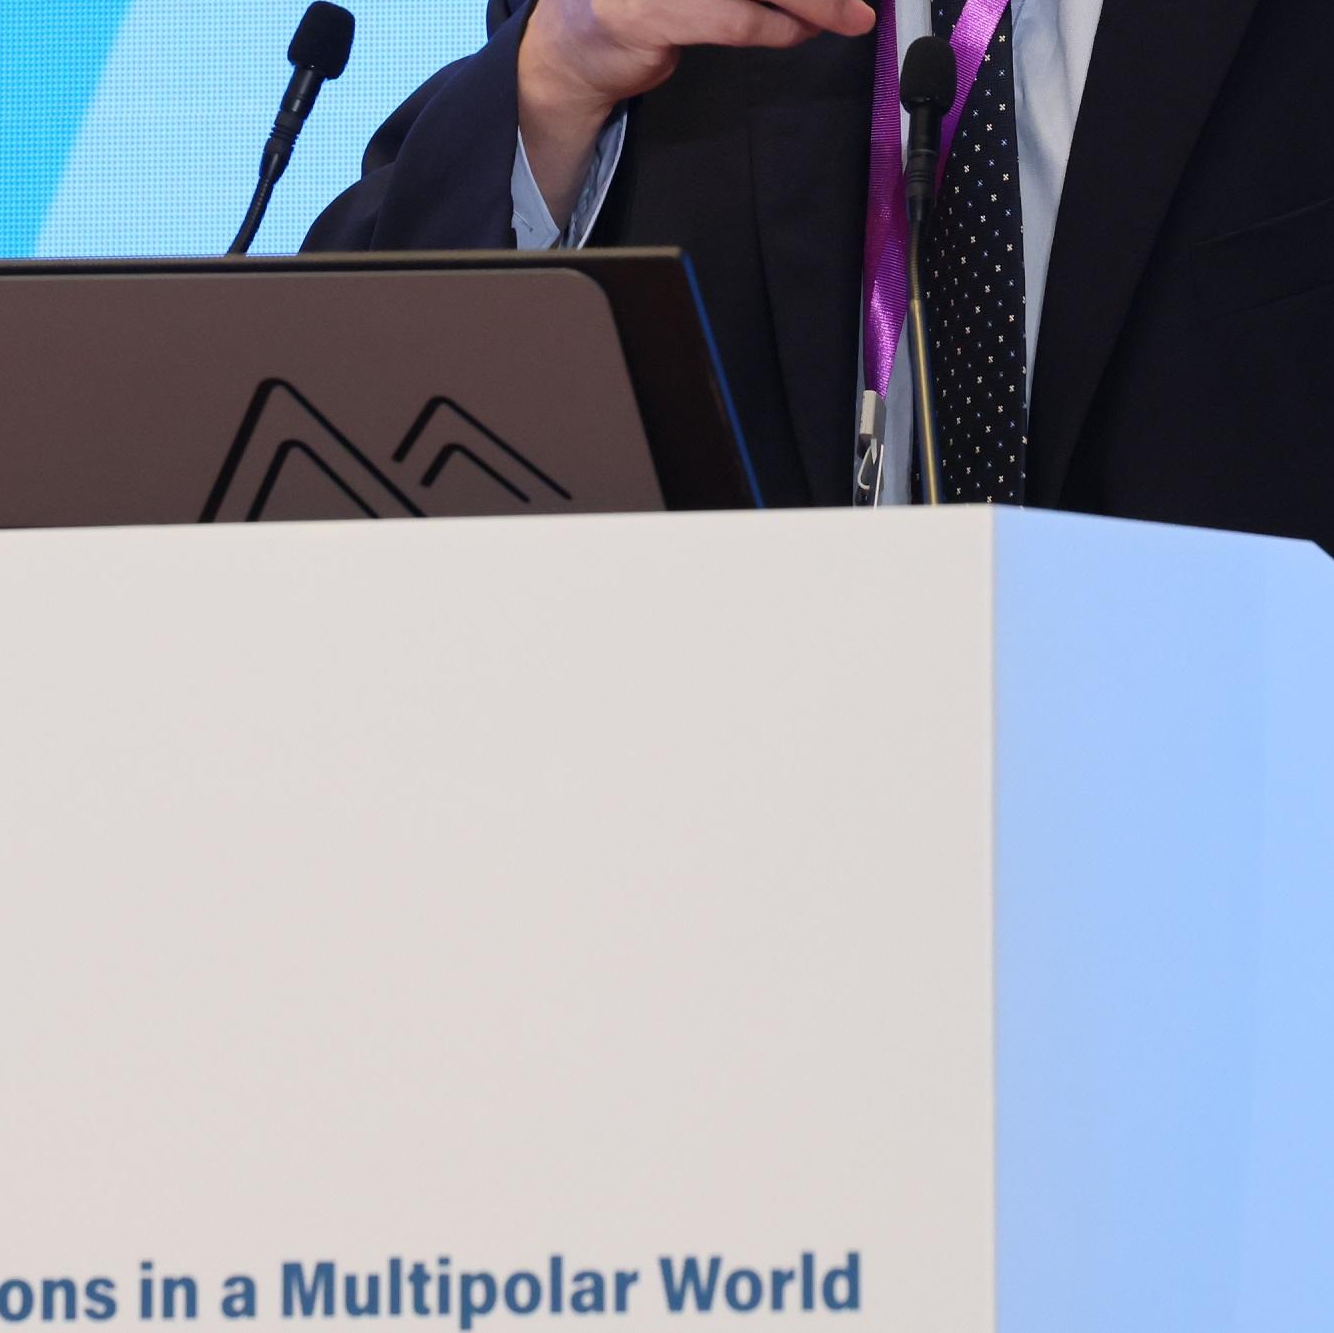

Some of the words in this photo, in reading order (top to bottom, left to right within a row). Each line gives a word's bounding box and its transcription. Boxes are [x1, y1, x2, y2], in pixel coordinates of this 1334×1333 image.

[139, 1261, 198, 1320] in
[220, 1274, 257, 1320] a
[281, 1255, 639, 1332] Multipolar
[657, 1251, 860, 1313] World
